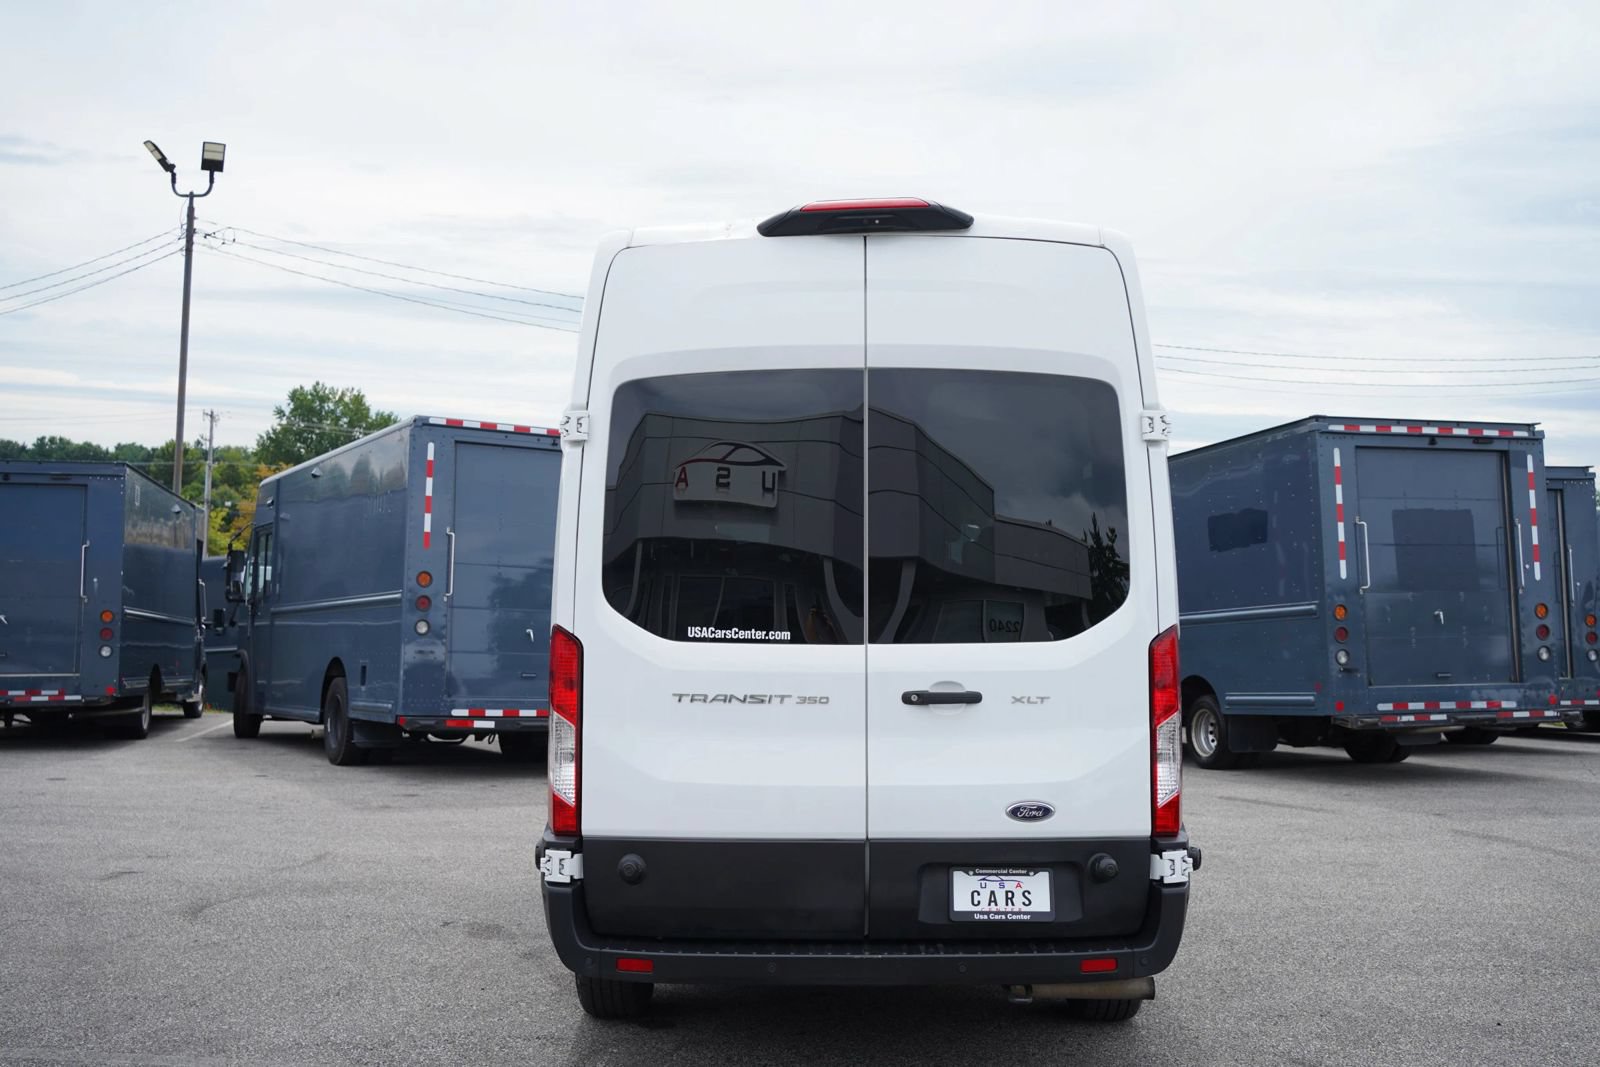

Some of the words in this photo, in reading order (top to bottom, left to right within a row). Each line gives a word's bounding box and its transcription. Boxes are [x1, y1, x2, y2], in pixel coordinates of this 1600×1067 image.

[687, 626, 791, 640] USACarsCenter.com
[672, 693, 792, 704] TRANSIT
[795, 696, 830, 704] 350
[1010, 696, 1050, 704] XLT
[1017, 805, 1044, 817] Ford
[970, 890, 1032, 907] CARS
